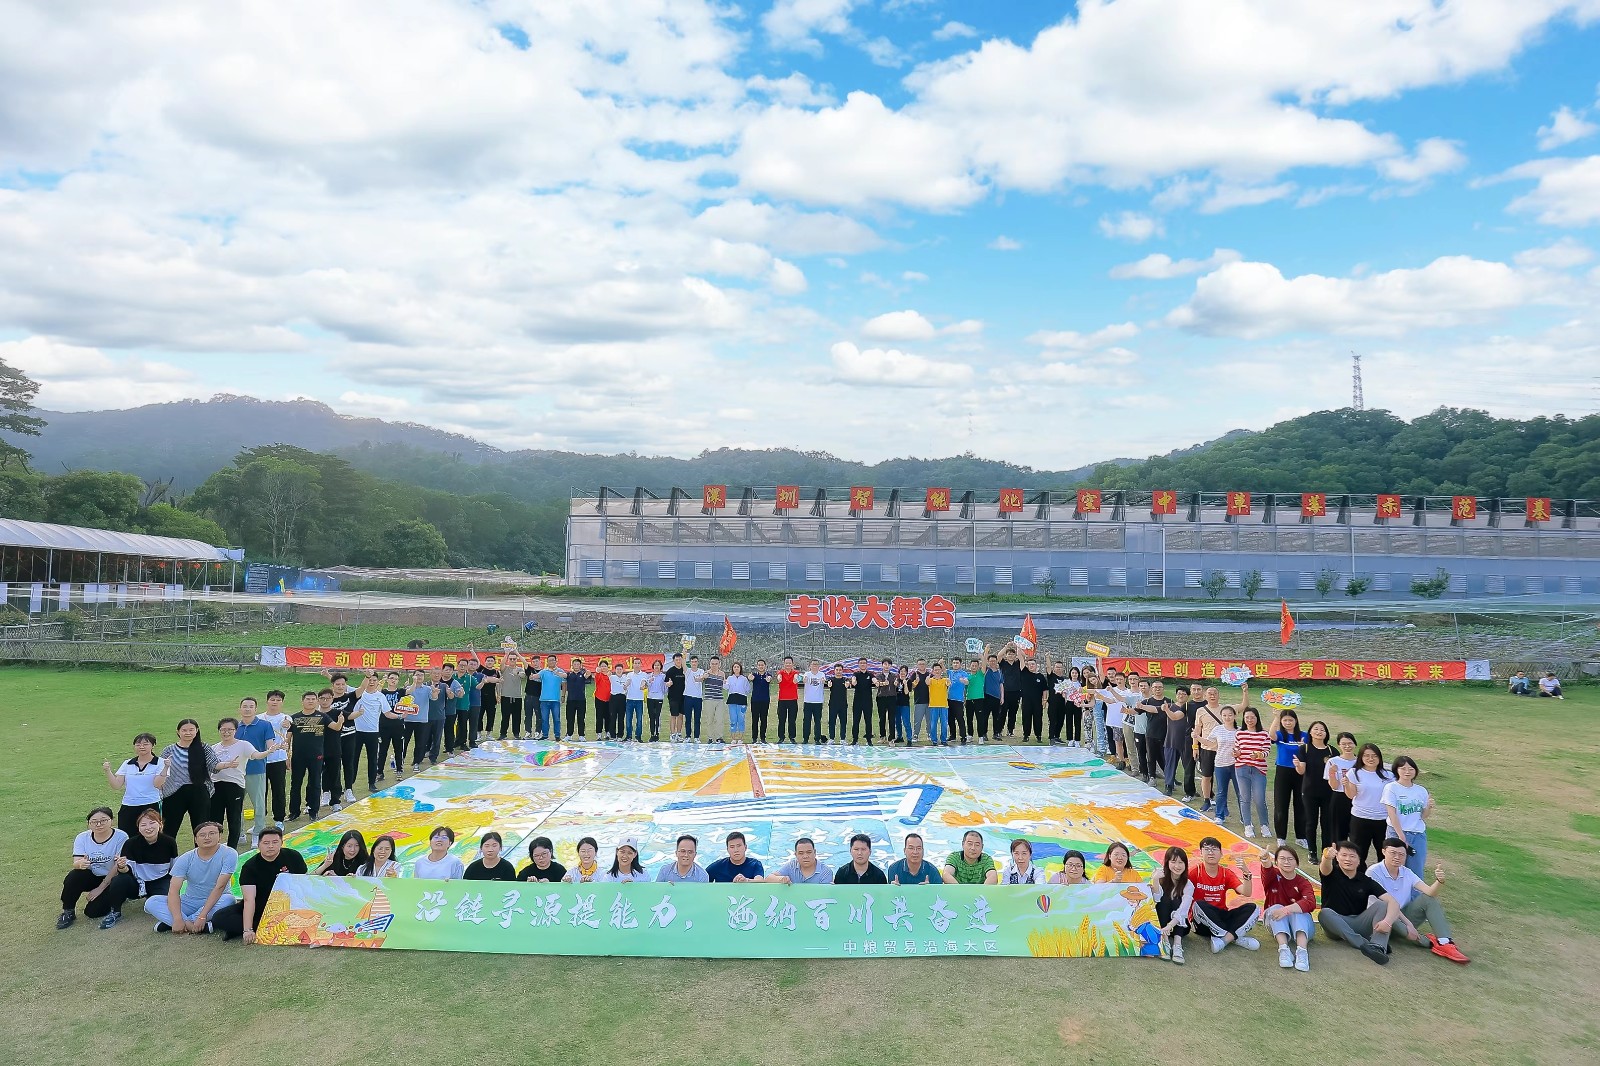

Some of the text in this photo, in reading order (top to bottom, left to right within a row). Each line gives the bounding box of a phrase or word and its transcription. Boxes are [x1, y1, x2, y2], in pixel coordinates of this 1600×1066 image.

[787, 595, 956, 629] 丰收大舞台
[1122, 660, 1443, 679] 人民创造史 劳动开创未来
[1196, 882, 1226, 892] BURBERR
